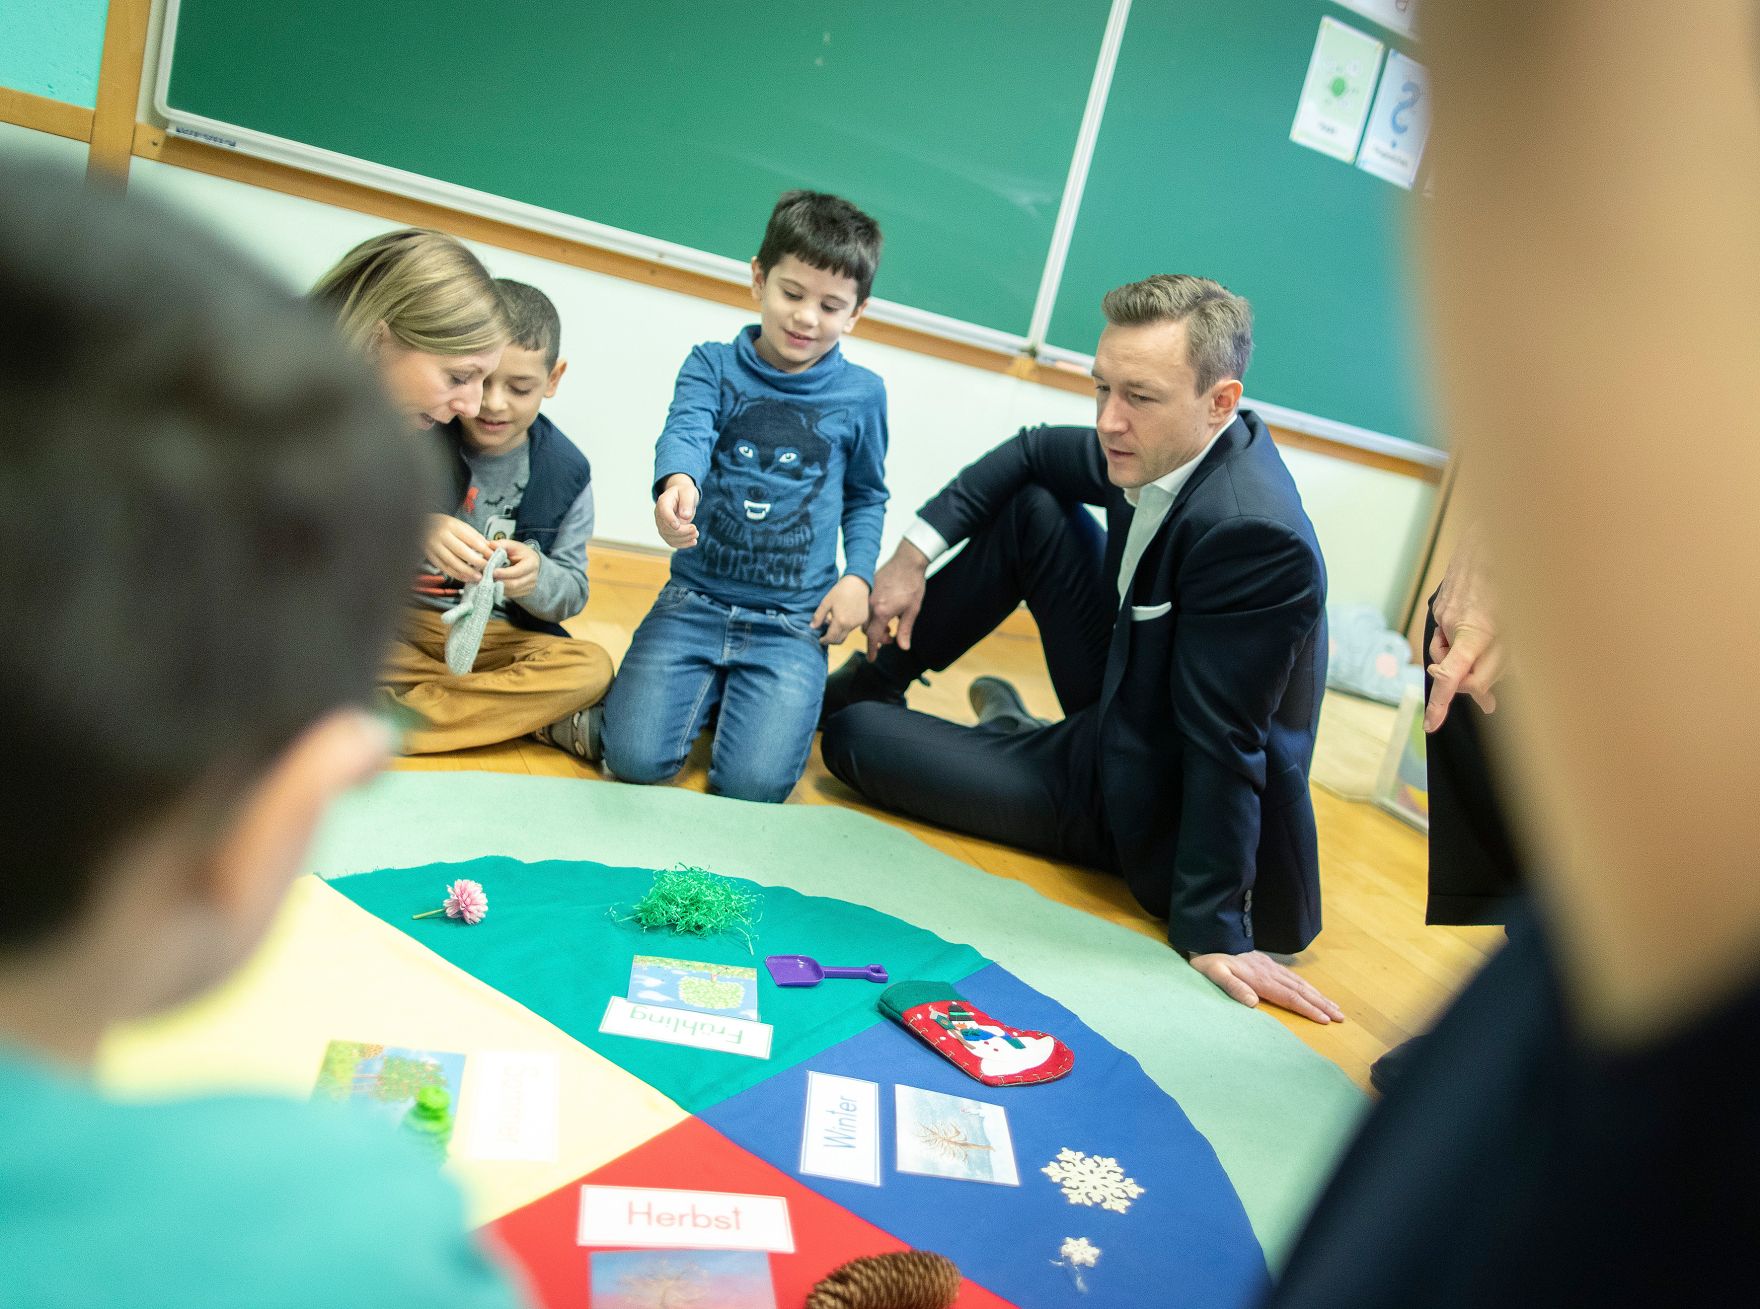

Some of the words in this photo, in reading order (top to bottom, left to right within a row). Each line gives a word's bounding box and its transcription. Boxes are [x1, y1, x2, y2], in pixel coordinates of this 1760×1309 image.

[704, 537, 807, 588] FOREST
[628, 1004, 744, 1045] Frühling
[822, 1095, 858, 1149] Winter
[627, 1200, 742, 1231] Herbst
